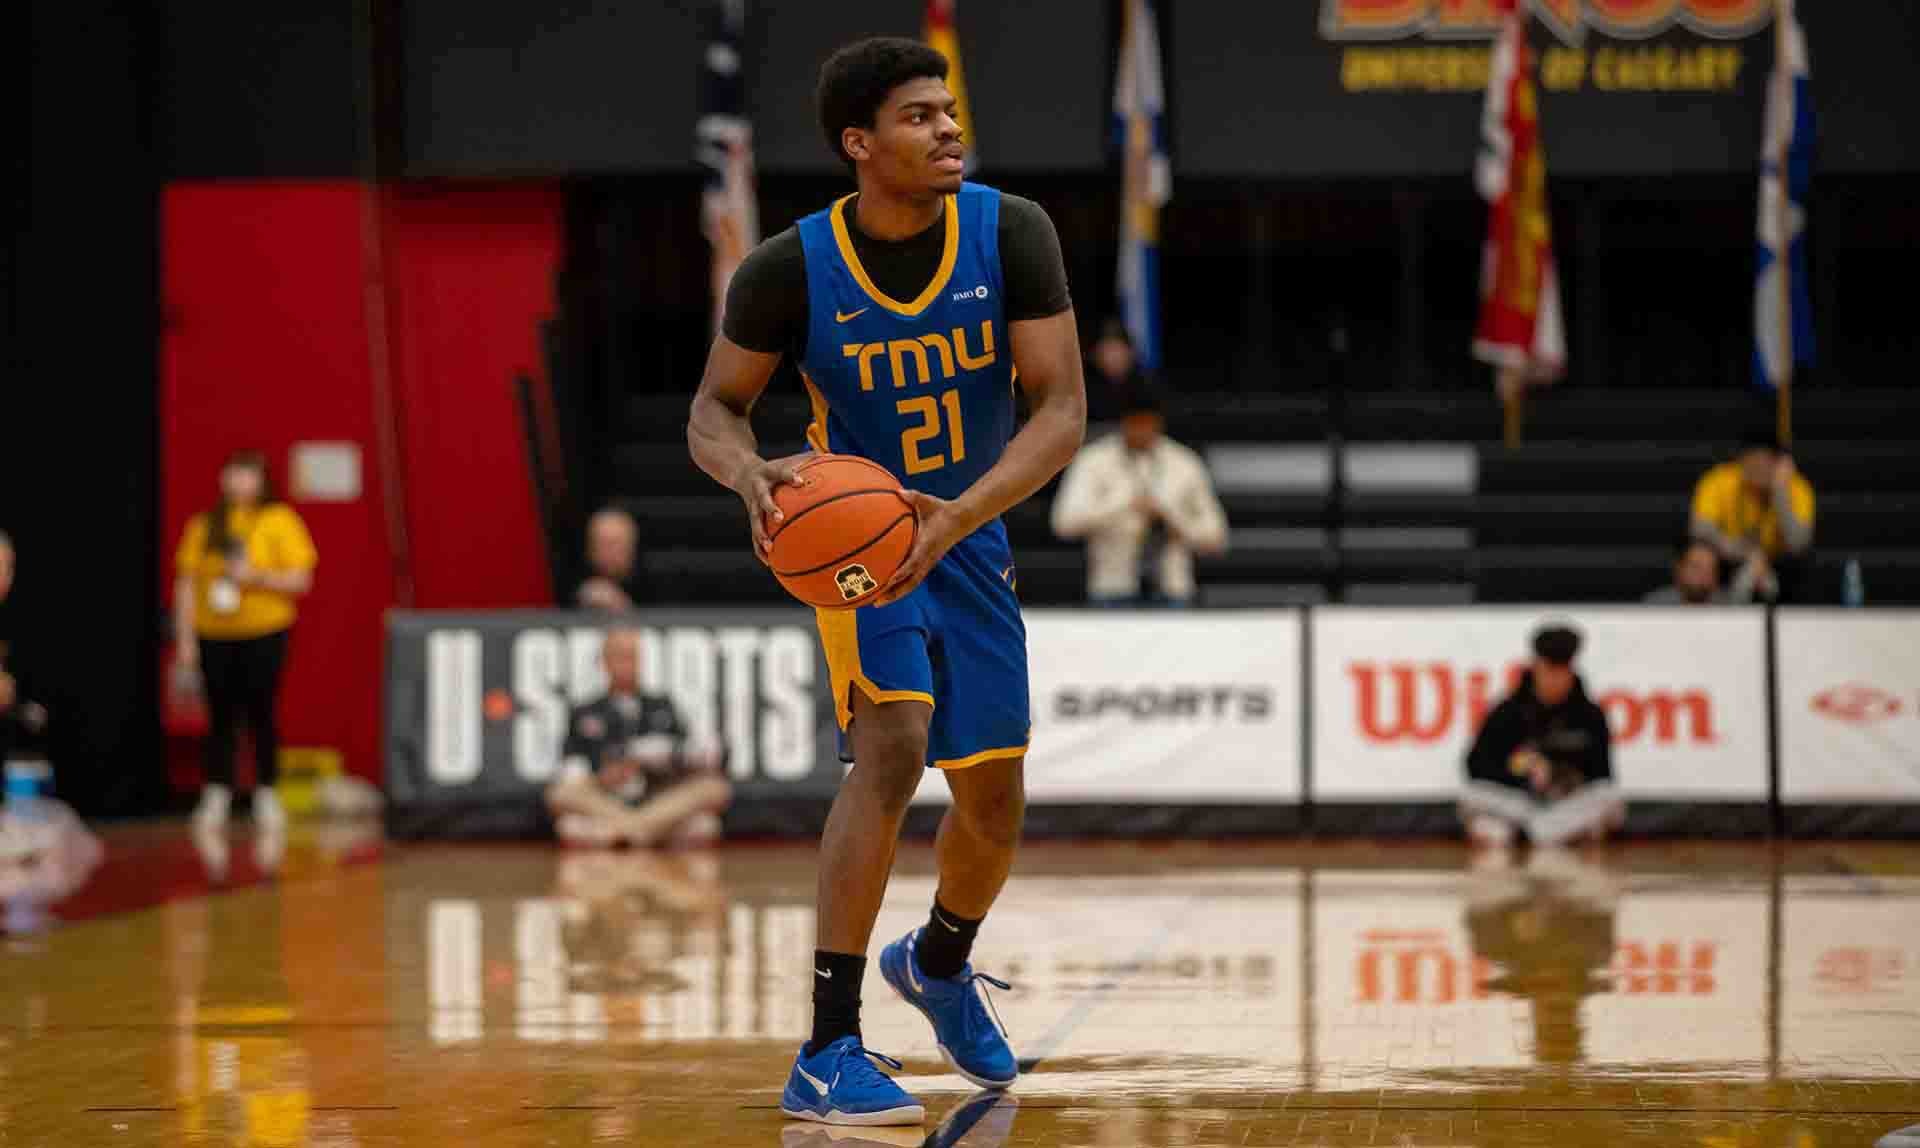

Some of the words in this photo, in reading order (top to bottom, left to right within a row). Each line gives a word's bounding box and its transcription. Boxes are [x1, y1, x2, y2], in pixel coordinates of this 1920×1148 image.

[843, 320, 996, 391] TMU
[897, 388, 966, 476] 21
[427, 629, 483, 785] U
[512, 627, 816, 782] SRTS
[1052, 684, 1274, 722] SPORTS
[1349, 661, 1719, 745] Wion
